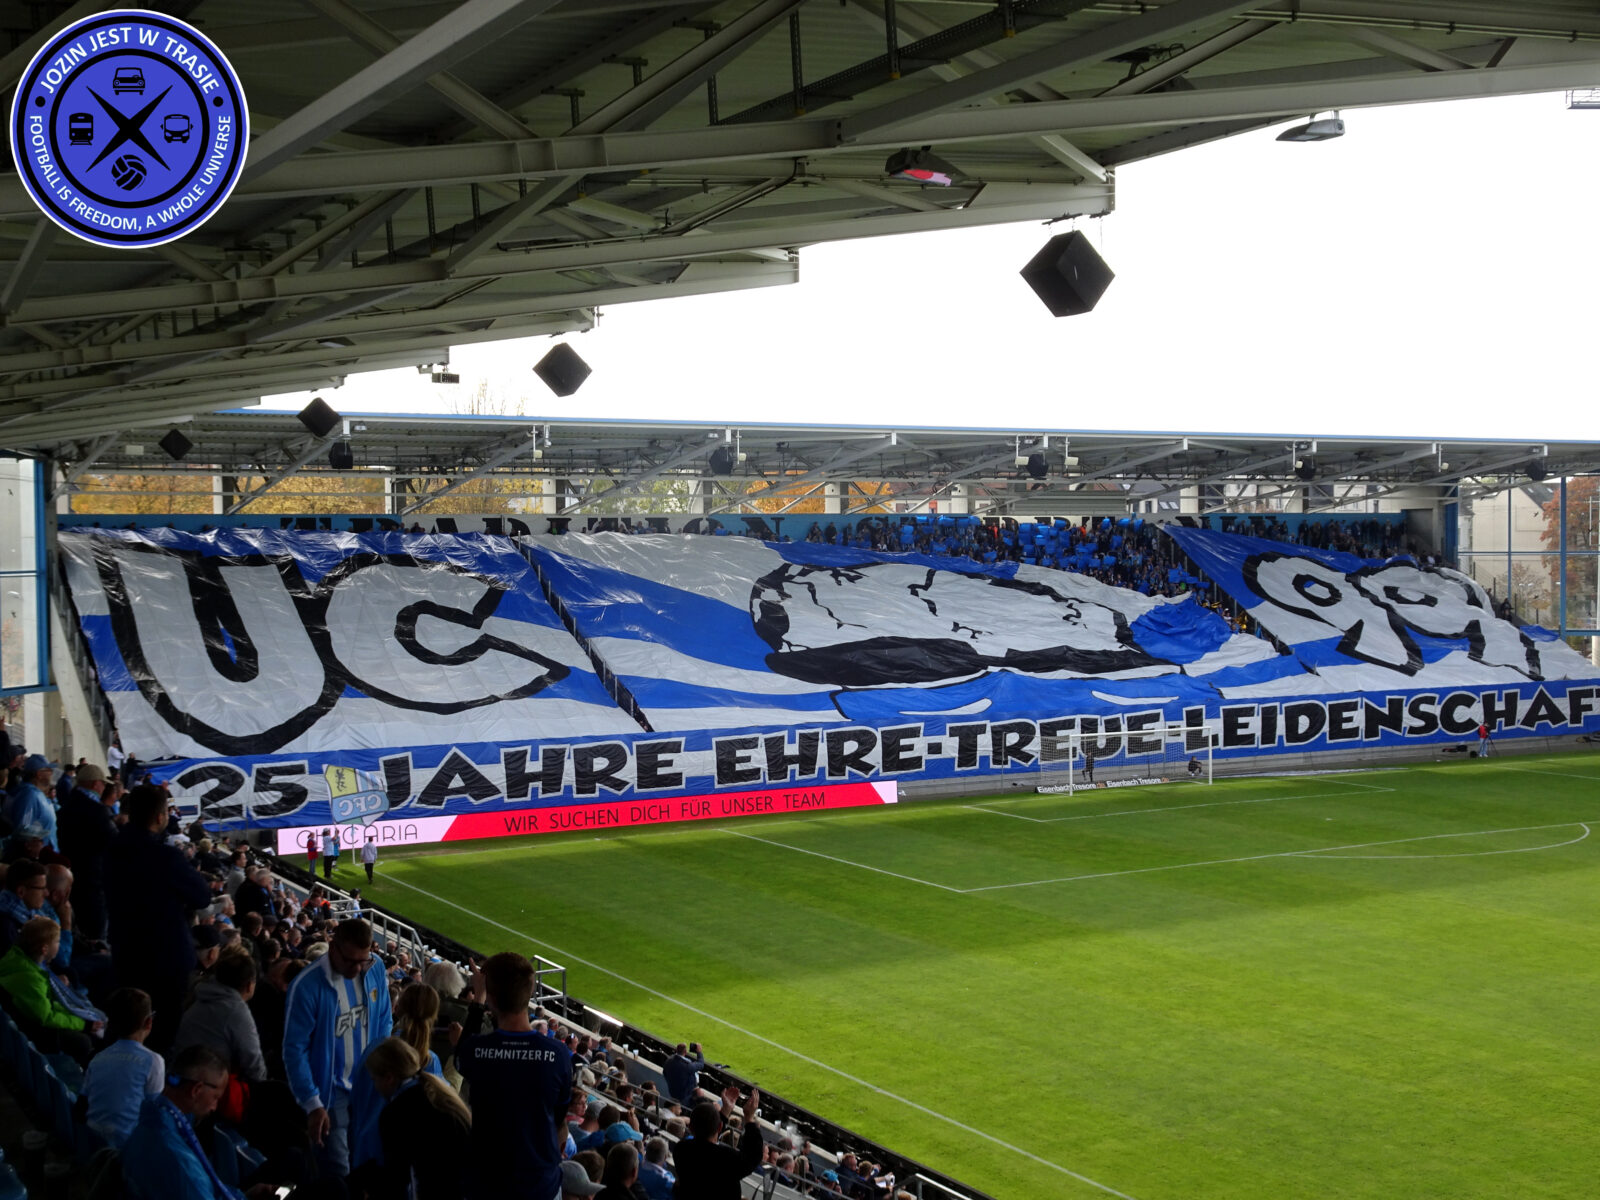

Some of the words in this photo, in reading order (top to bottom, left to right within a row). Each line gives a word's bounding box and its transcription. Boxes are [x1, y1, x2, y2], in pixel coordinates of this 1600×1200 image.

[90, 537, 571, 756] UC
[169, 760, 309, 822] 25
[378, 737, 687, 811] JAHRE
[714, 685, 1600, 789] EHRE-TREUE-LEIDENSCHAF
[504, 815, 538, 833] WIR
[549, 808, 620, 829] SUCHEN
[630, 804, 671, 822] DICH
[681, 799, 711, 818] FÜR
[721, 796, 774, 815] UNSER
[783, 792, 826, 809] TEAM
[474, 1047, 542, 1061] CHEMNITZER
[544, 1050, 555, 1062] FC
